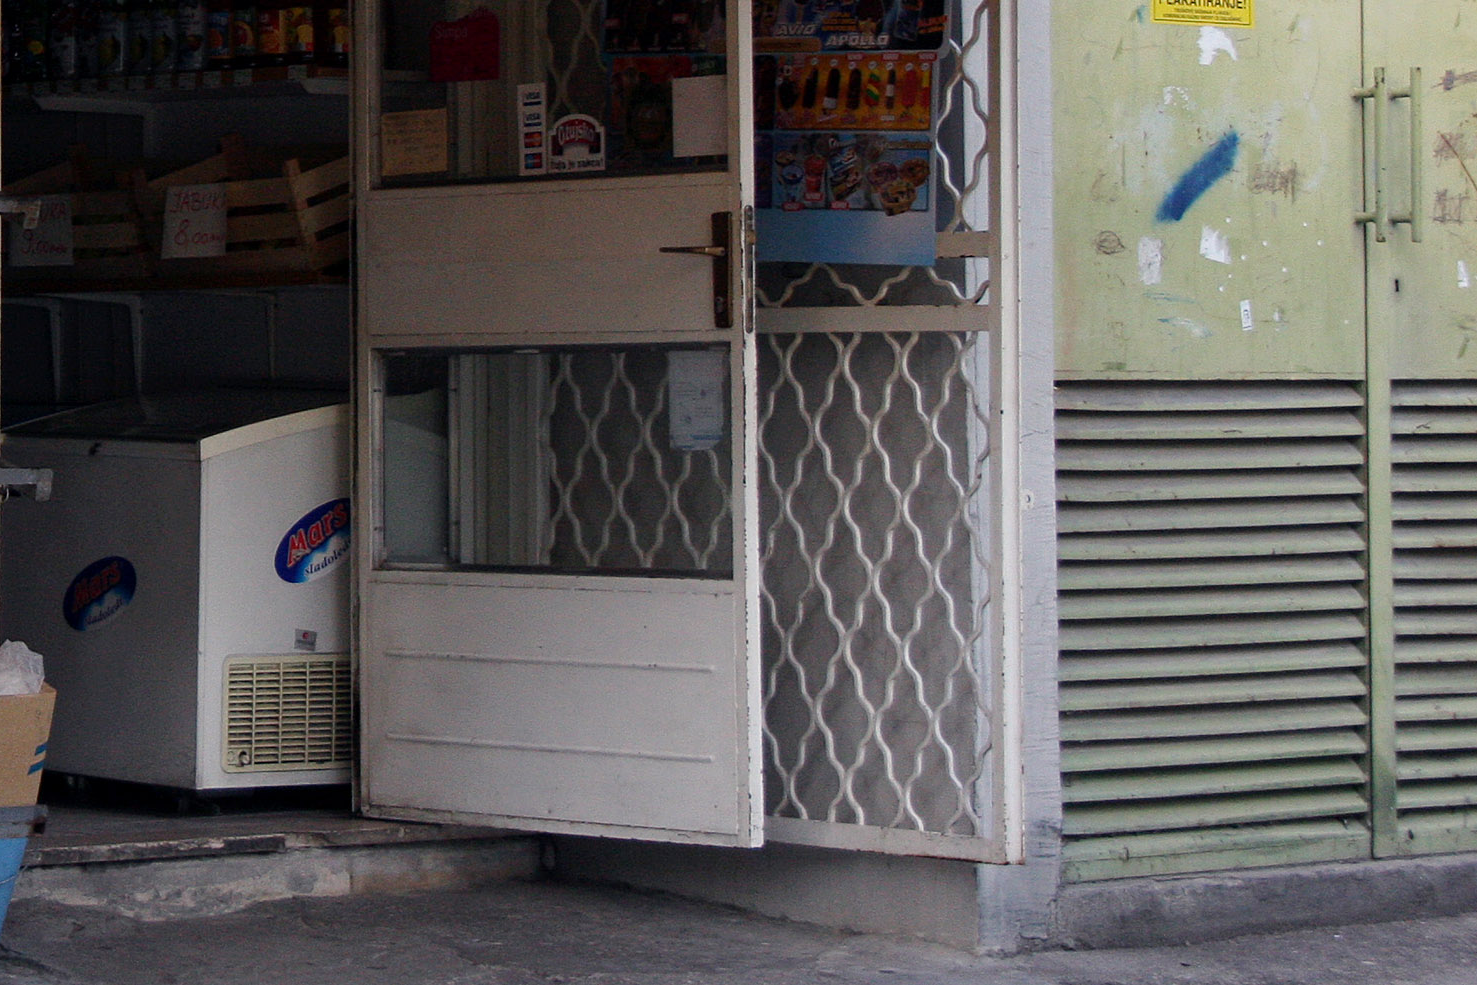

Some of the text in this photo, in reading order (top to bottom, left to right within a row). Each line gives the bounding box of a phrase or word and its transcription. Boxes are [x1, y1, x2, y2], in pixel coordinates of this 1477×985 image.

[825, 32, 890, 46] APOLLO
[286, 503, 348, 568] Mars
[71, 561, 122, 614] Mars
